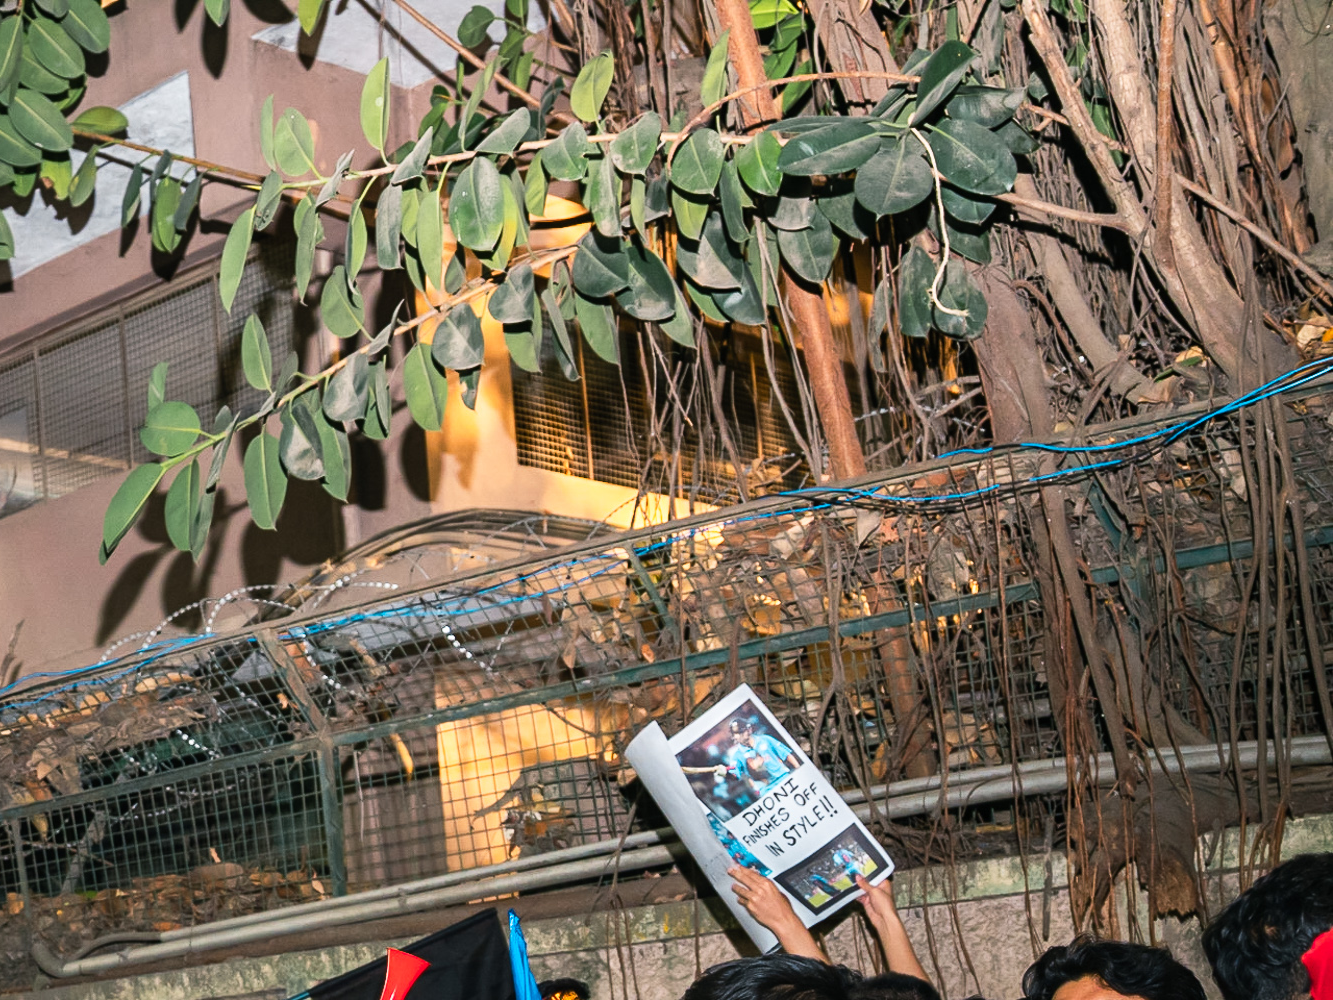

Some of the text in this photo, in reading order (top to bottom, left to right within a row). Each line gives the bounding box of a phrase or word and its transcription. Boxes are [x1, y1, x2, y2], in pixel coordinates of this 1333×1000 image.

[742, 777, 799, 827] DHONI
[742, 782, 817, 847] FINISHES OFF
[765, 795, 838, 857] IN STYLE!!
